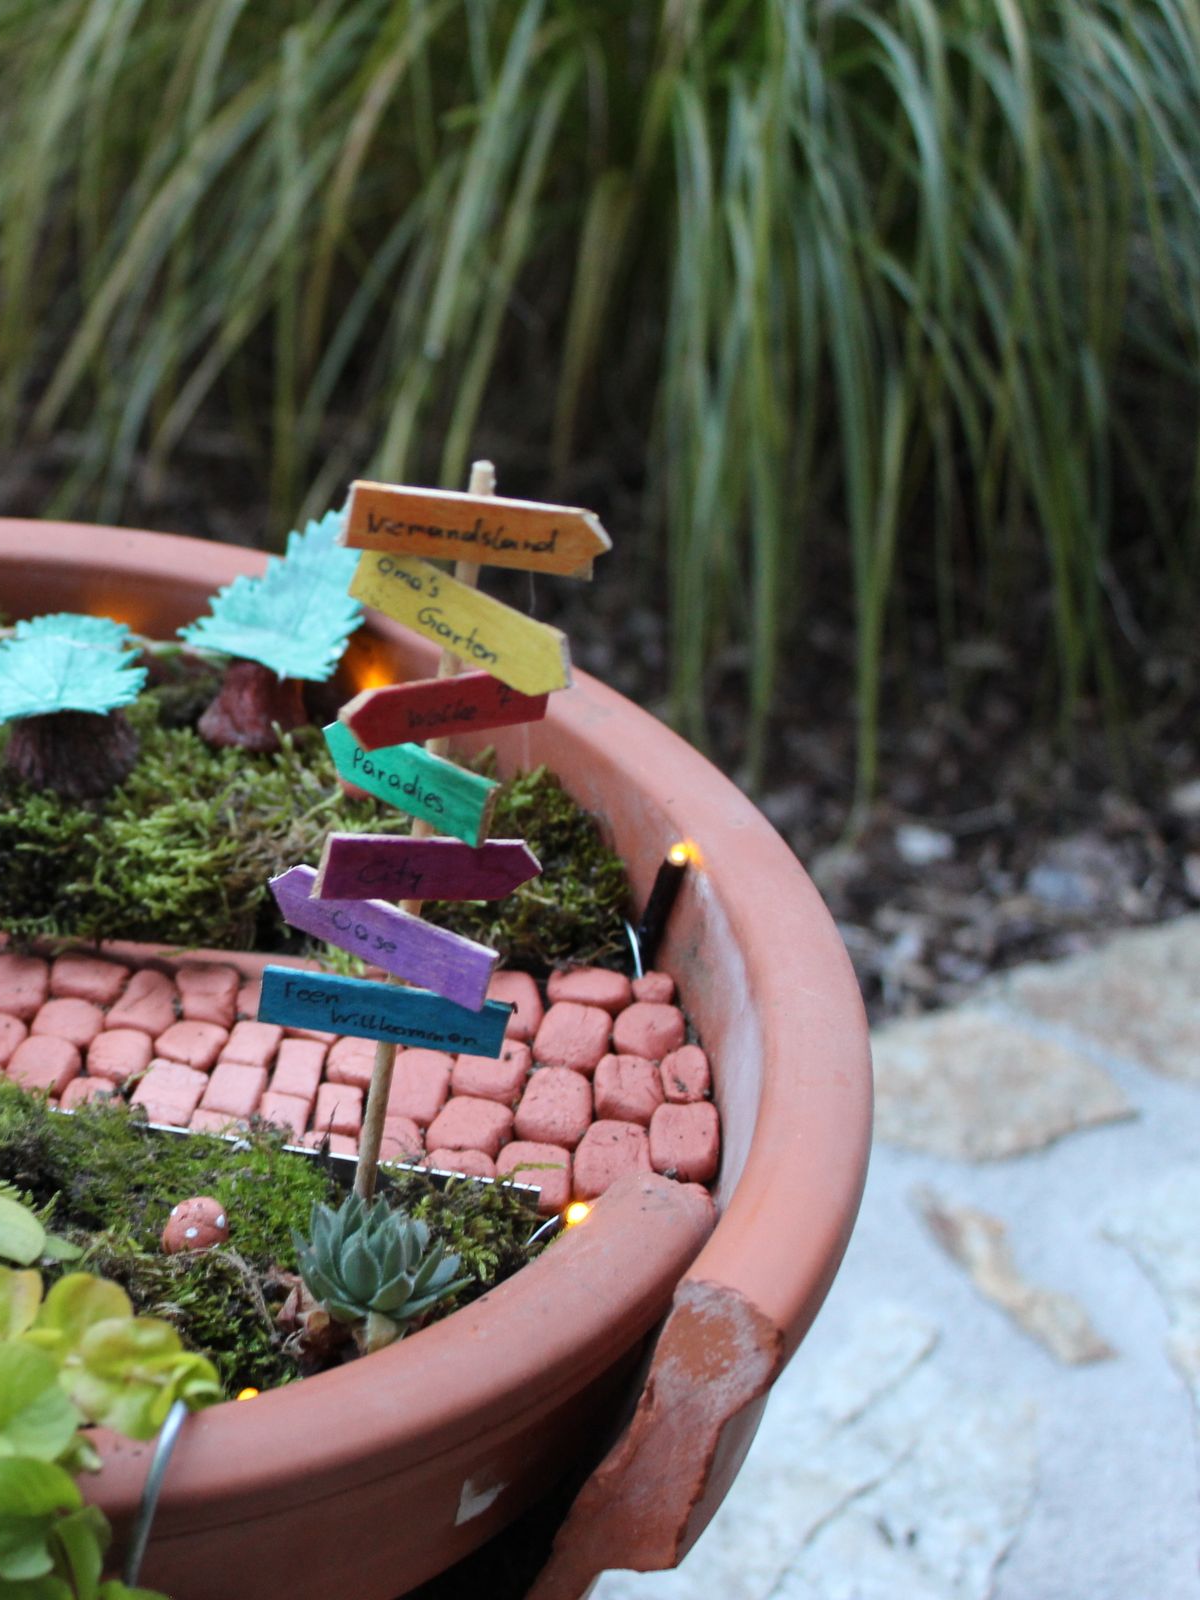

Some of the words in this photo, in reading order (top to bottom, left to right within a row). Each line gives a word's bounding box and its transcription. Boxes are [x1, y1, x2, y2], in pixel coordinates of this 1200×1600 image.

[377, 557, 439, 598] Oma's
[417, 607, 497, 664] Garten
[353, 746, 444, 813] Paradies
[358, 856, 423, 893] City
[332, 910, 397, 953] Oase
[284, 981, 339, 1005] Feen
